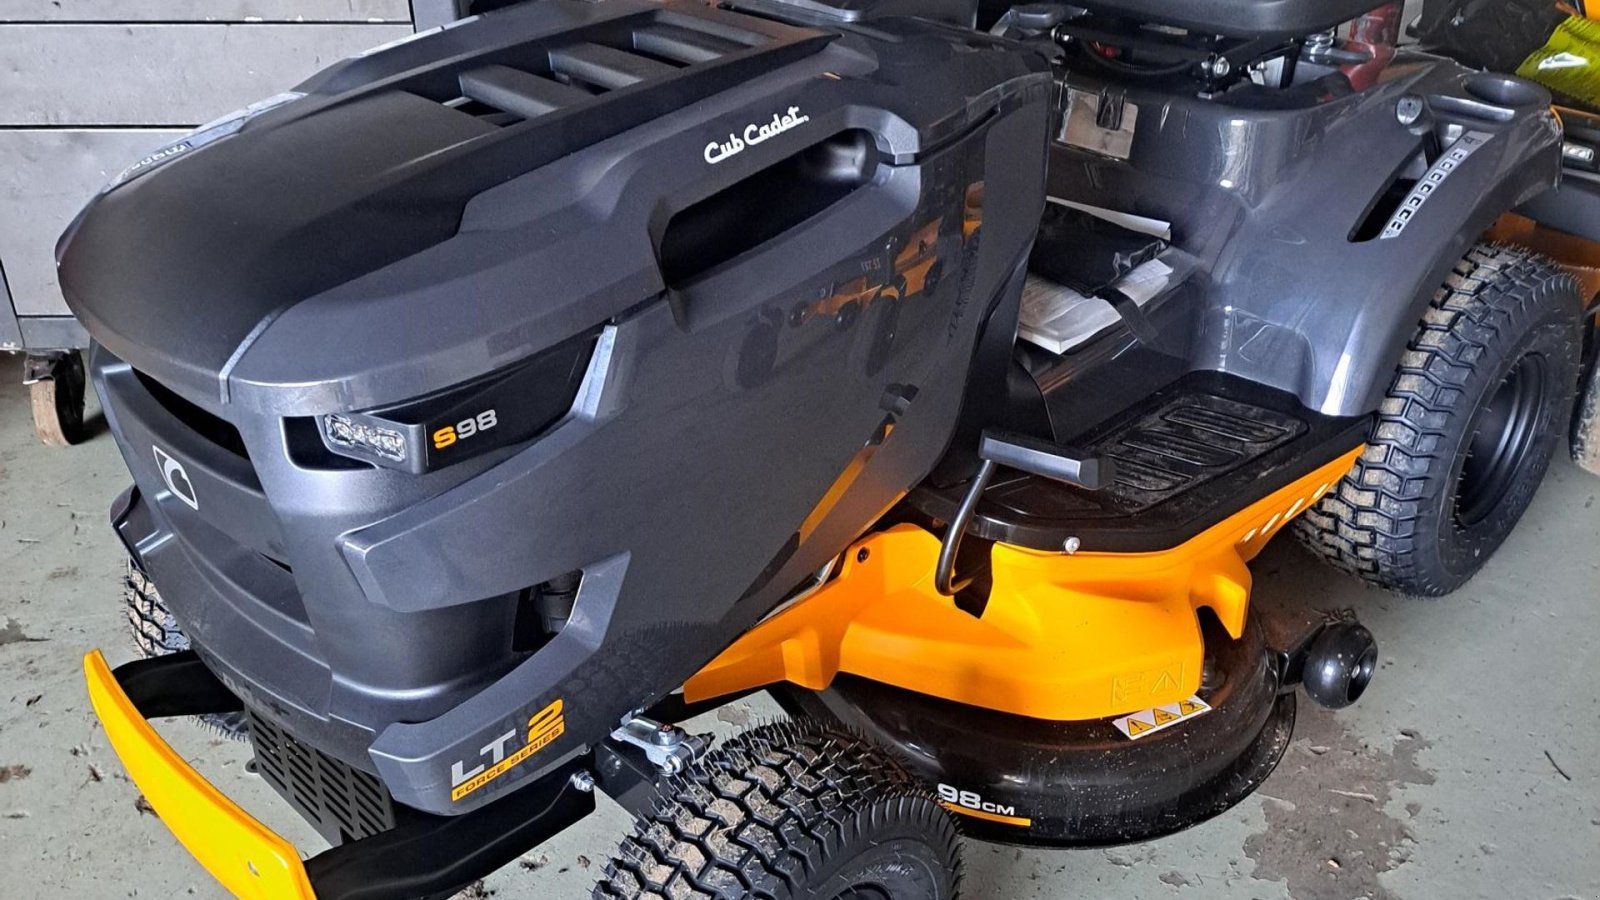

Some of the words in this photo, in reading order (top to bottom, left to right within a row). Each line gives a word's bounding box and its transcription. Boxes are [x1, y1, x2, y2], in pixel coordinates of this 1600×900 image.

[703, 133, 745, 164] Cub
[433, 409, 498, 449] S98
[456, 763, 506, 798] FORCE
[510, 727, 560, 765] SERIES
